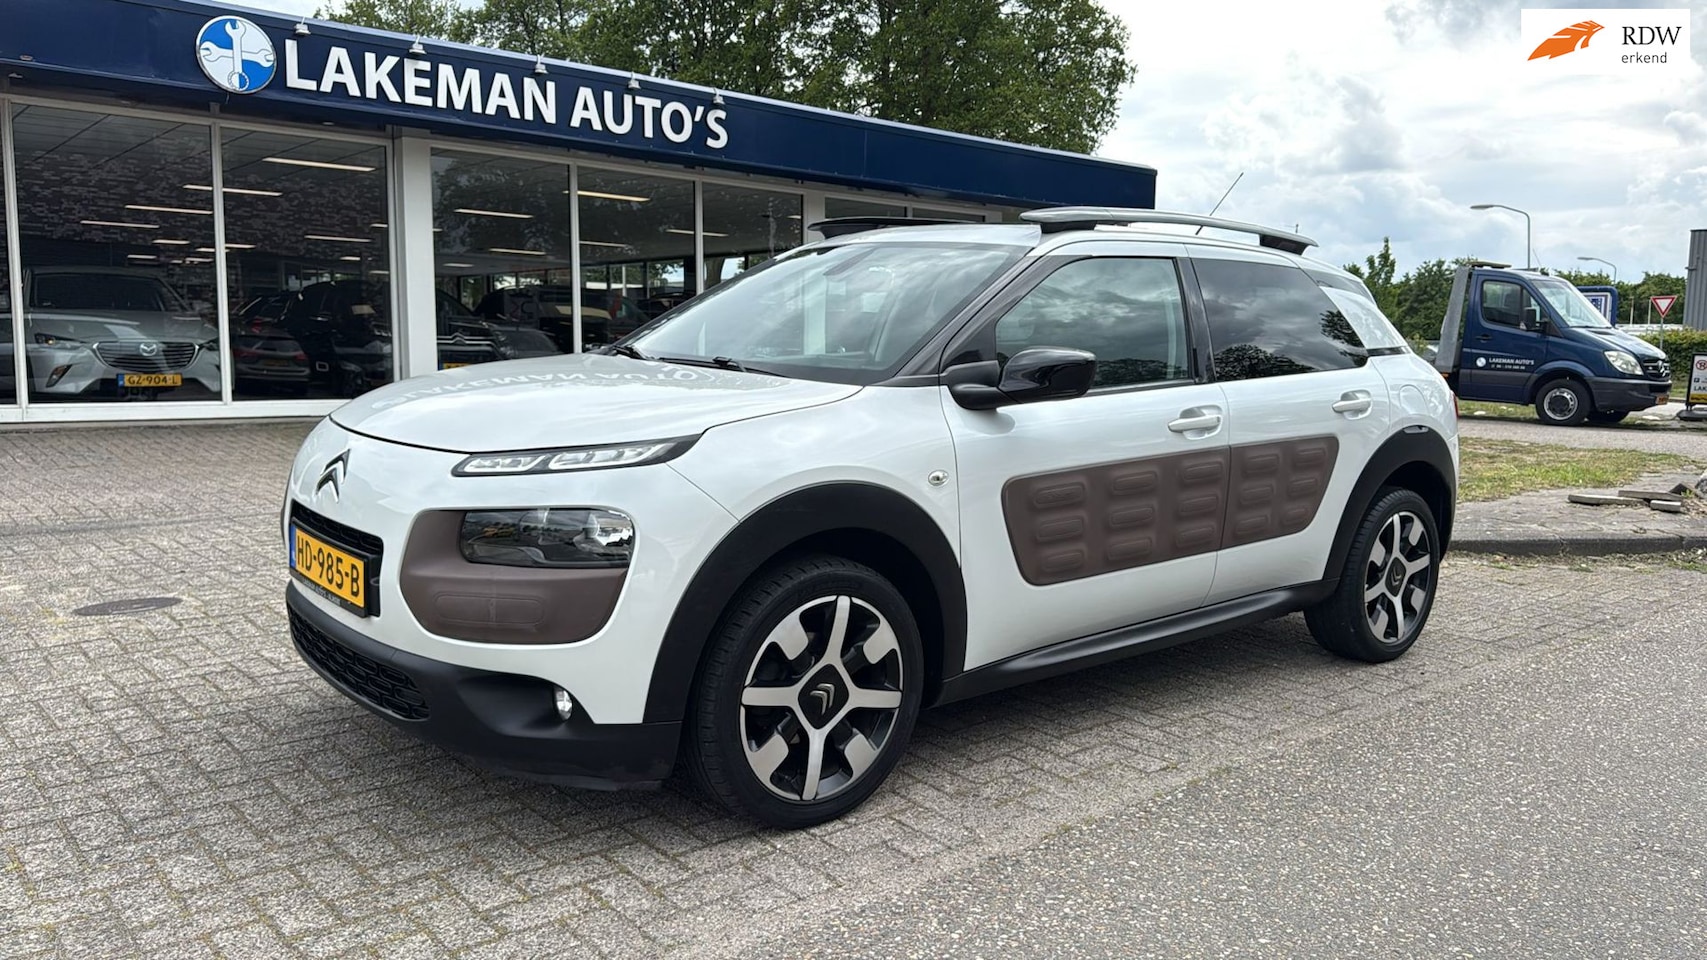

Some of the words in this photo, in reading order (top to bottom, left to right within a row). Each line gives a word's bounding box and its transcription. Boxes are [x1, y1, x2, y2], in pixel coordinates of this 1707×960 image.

[284, 38, 557, 125] LAKEMAN
[569, 85, 729, 150] AUTO'S
[297, 535, 360, 598] HD-985-B
